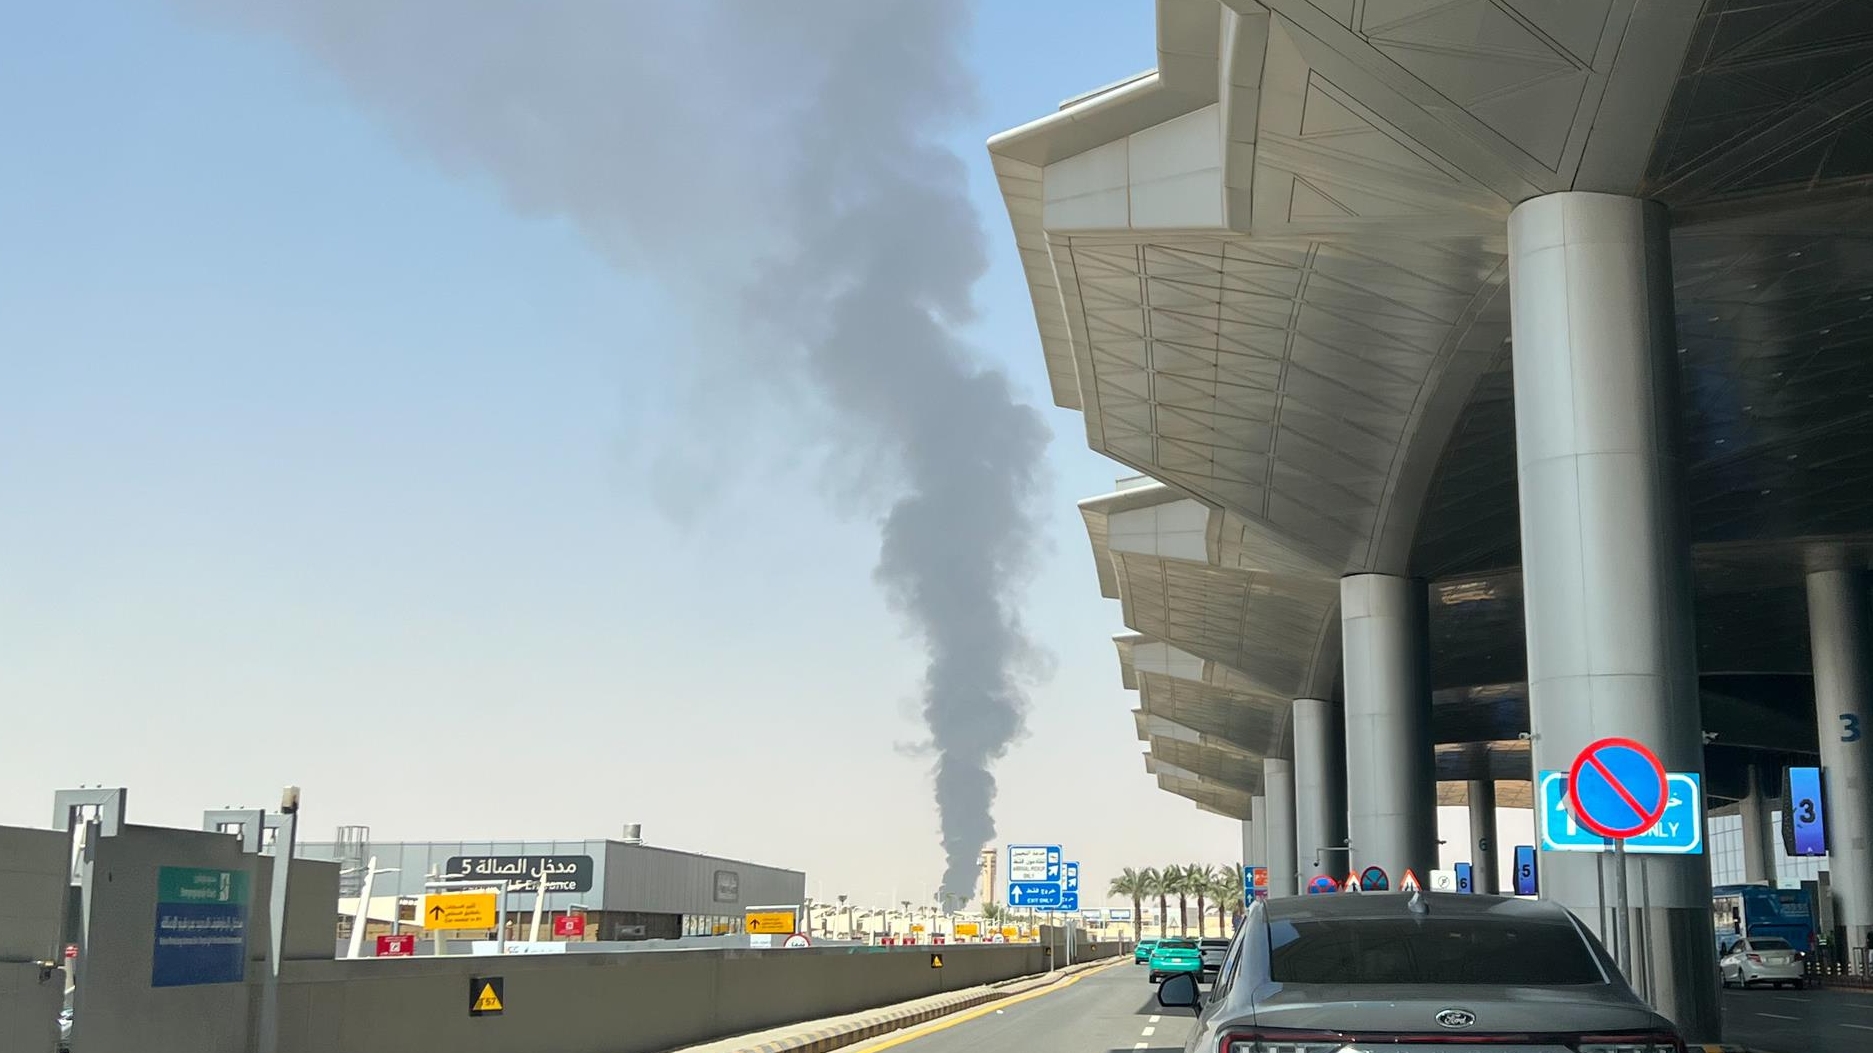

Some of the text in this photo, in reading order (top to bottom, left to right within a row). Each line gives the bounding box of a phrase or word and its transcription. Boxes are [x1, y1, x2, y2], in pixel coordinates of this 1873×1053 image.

[1839, 713, 1861, 742] 3
[1799, 799, 1816, 823] 3
[1640, 821, 1679, 837] NLY
[1479, 838, 1487, 851] 6
[462, 858, 577, 877] مدخل الصالة 5
[1522, 864, 1531, 877] 5
[1460, 878, 1468, 889] 6
